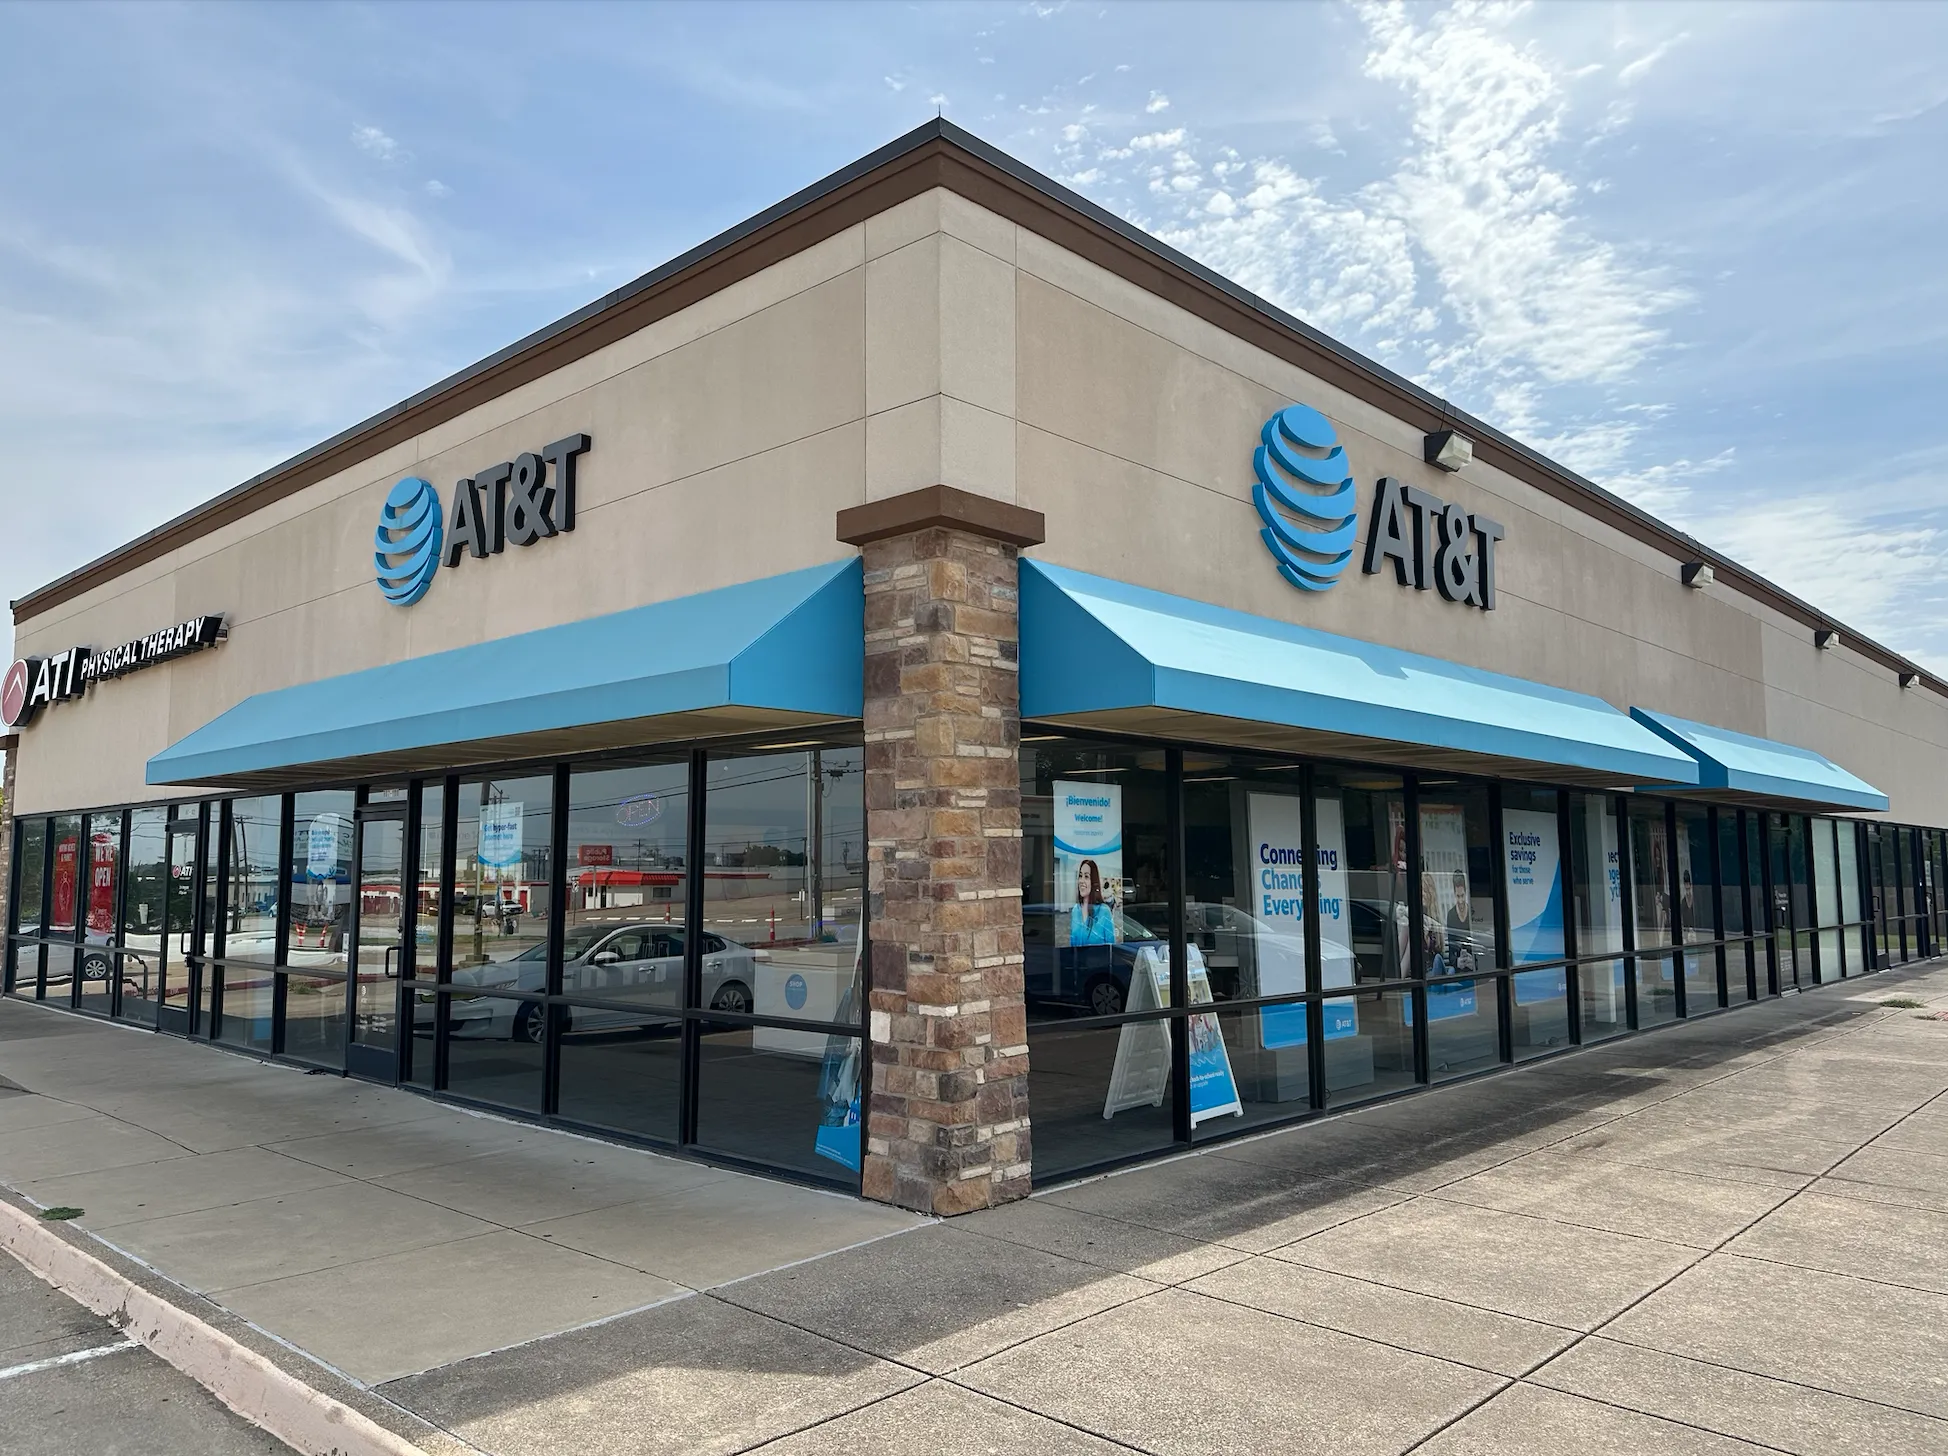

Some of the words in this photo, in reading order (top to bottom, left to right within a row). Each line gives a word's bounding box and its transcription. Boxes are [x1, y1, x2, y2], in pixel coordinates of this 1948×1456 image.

[443, 433, 591, 567] AT&T
[1362, 476, 1504, 611] AT&T
[80, 641, 138, 680] PHYSICAL
[141, 616, 206, 659] THERAPY
[30, 647, 81, 706] ATI
[1066, 795, 1110, 807] ¡Bienvenido!
[1074, 813, 1103, 822] Welcome!
[1509, 831, 1540, 846] Exclusive
[1260, 843, 1338, 871] Conneing
[1510, 847, 1536, 865] savings
[94, 867, 112, 887] OPEN
[180, 866, 193, 876] ATI
[1263, 893, 1340, 921] Everying
[789, 980, 803, 988] SHOP
